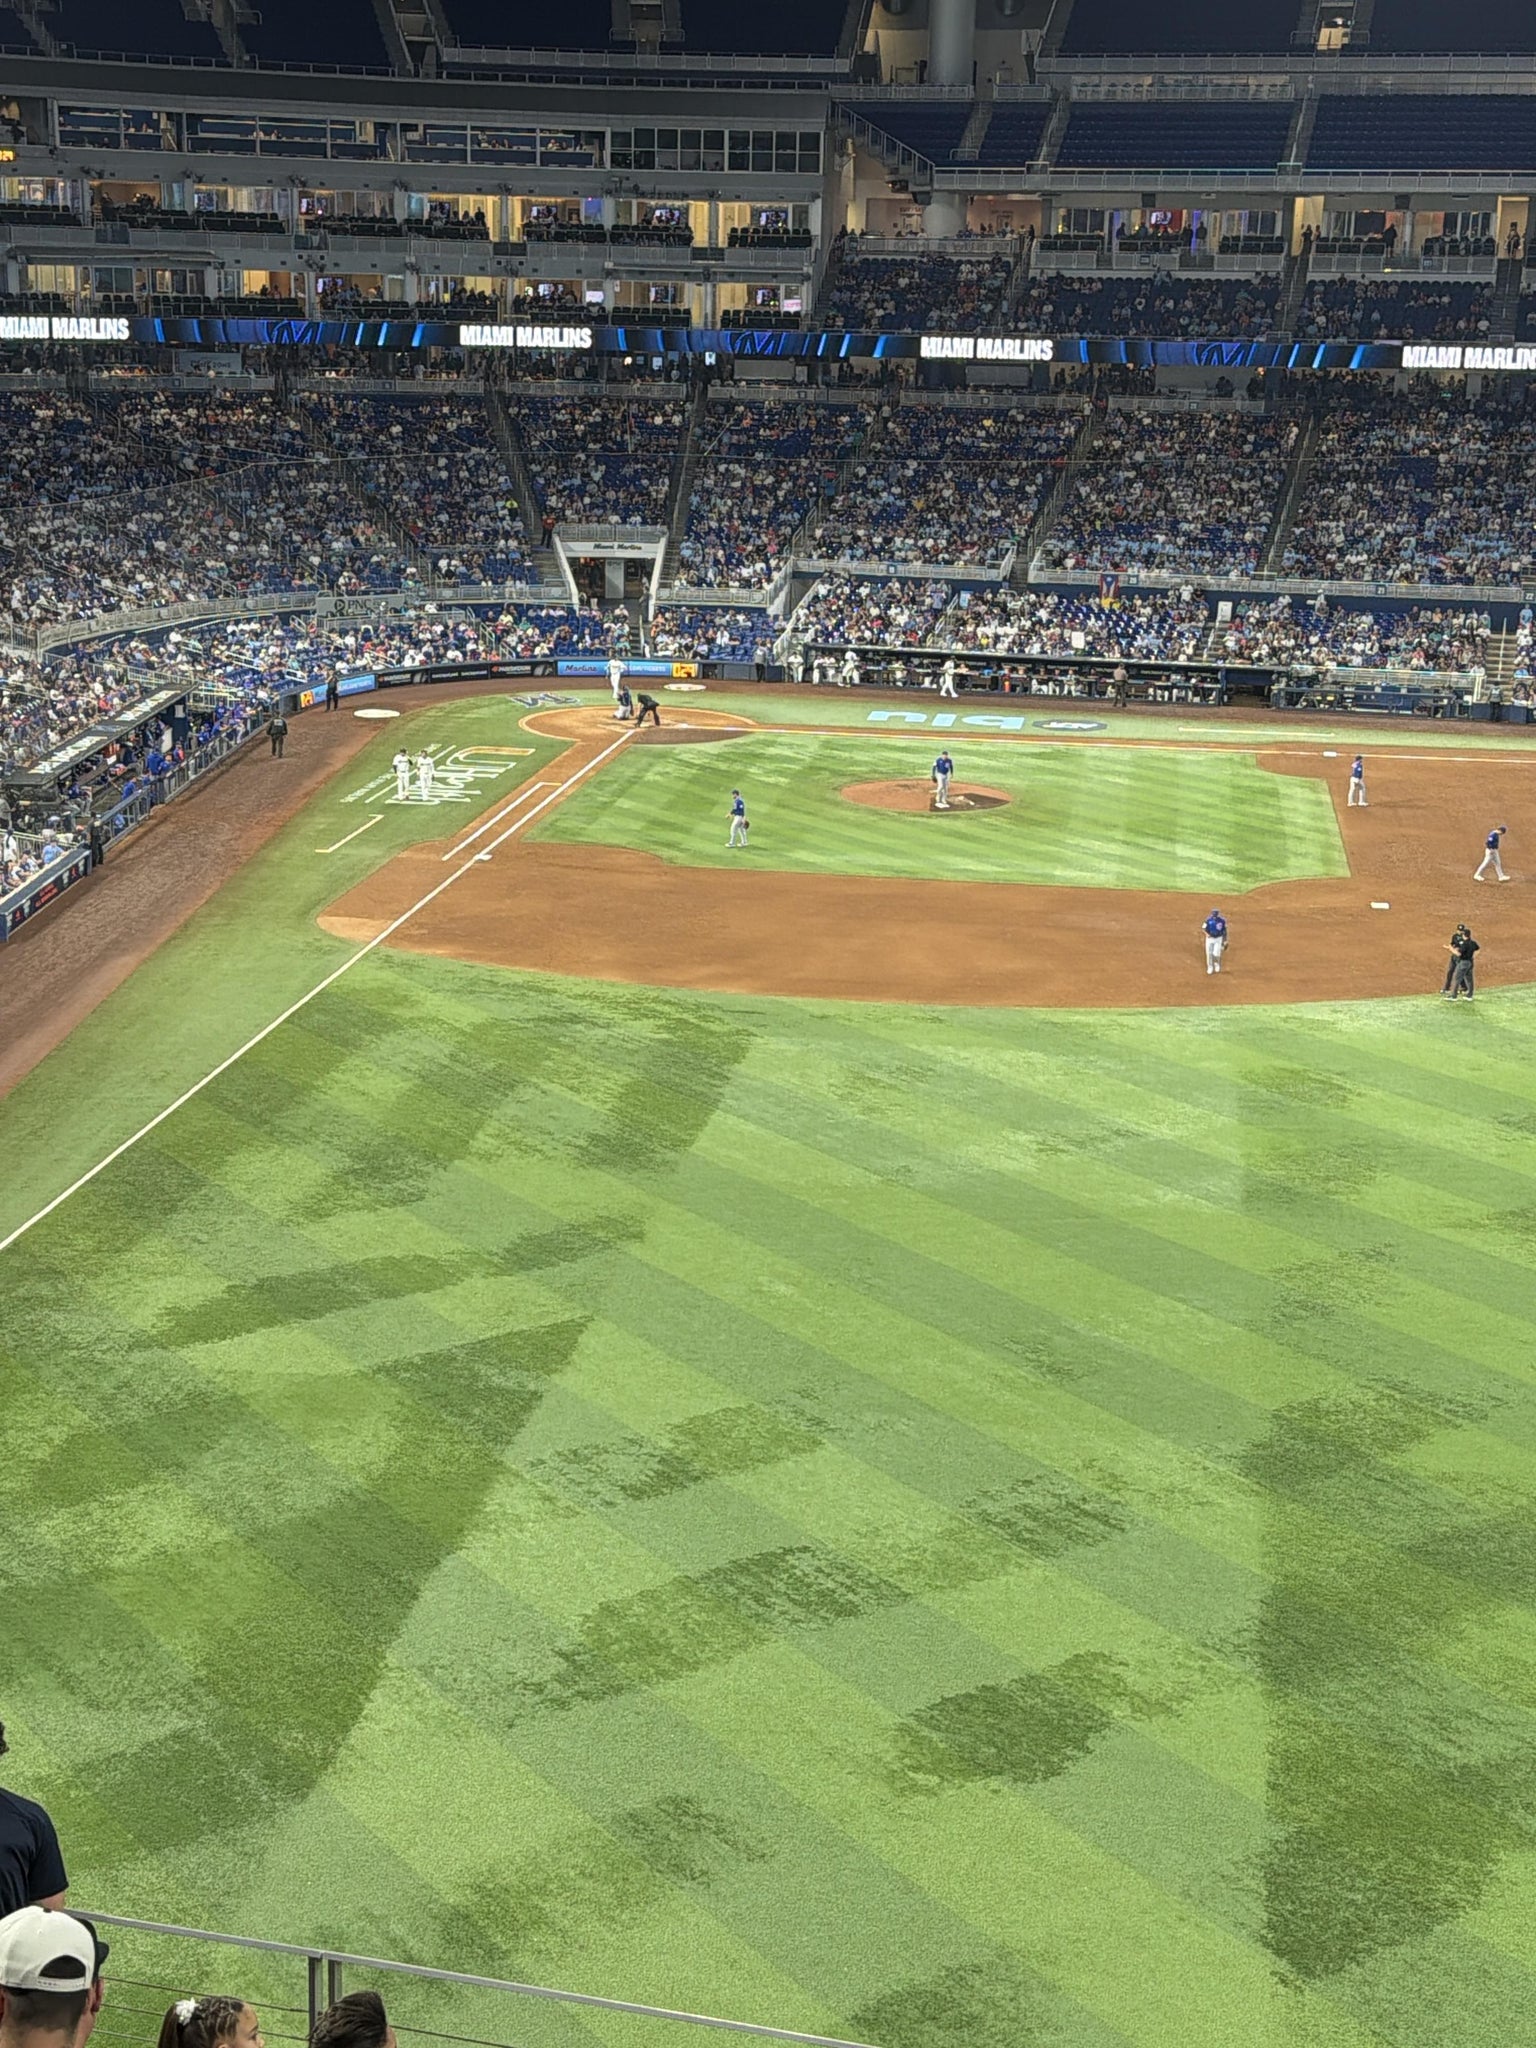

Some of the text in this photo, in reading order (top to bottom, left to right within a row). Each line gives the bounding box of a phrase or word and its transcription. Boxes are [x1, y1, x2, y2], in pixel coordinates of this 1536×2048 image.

[0, 316, 130, 340] MIAMI MARLINS
[460, 325, 592, 348] MIAMI MARLINS
[921, 337, 1053, 360] MIAMI MARLINS
[1402, 345, 1536, 370] MIAMI MARLIN
[617, 543, 642, 551] Marlins
